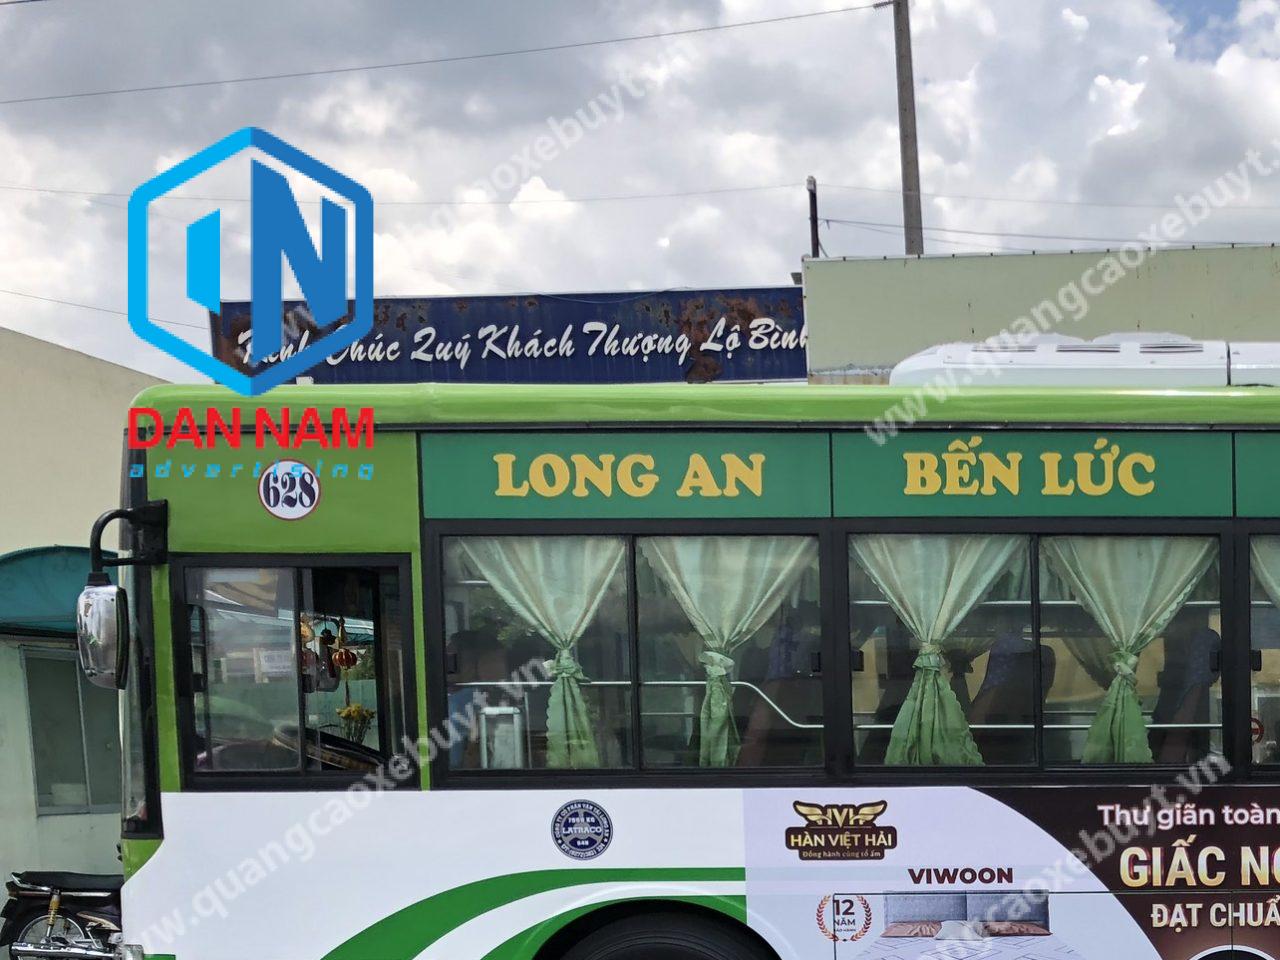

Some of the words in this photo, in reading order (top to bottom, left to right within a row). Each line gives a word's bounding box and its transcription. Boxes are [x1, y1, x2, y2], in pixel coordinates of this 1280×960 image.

[410, 326, 471, 370] Quý
[478, 324, 575, 359] Khách
[583, 321, 692, 366] Thượng
[700, 317, 742, 359] Lộ
[493, 453, 660, 498] LONG
[676, 453, 766, 498] AN
[902, 436, 1023, 496] BẾN
[1040, 437, 1156, 497] LỨC
[262, 471, 316, 508] 628
[562, 826, 602, 834] LATRACO
[1097, 804, 1149, 826] Thư
[1157, 803, 1215, 830] giãn
[790, 831, 825, 847] HÀN
[828, 831, 861, 849] VIỆT
[865, 831, 892, 847] HẢI
[907, 867, 1013, 884] VIWOON
[1120, 834, 1226, 888] GIẤC
[833, 899, 855, 916] 12
[834, 917, 856, 926] NĂM
[1151, 902, 1203, 933] ĐẠT
